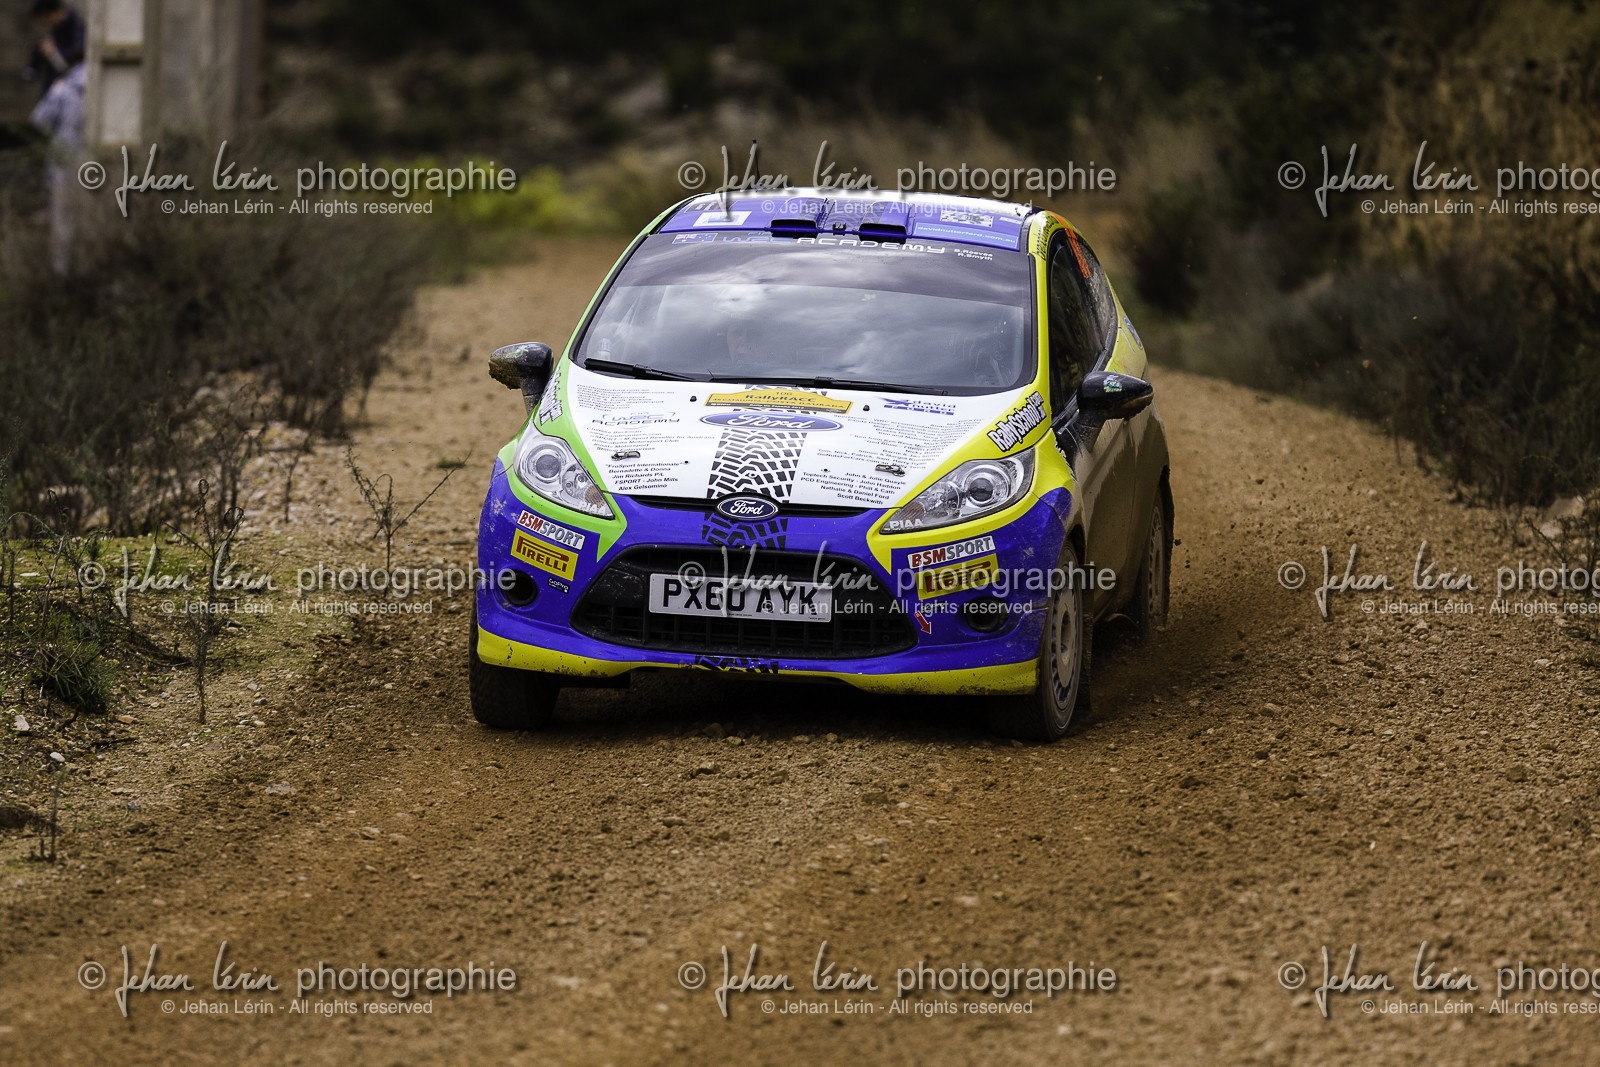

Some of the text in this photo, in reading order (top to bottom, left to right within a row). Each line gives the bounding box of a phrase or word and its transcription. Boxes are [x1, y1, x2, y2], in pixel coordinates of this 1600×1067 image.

[796, 237, 946, 254] ACADEMY
[592, 418, 680, 426] ACADEMY
[727, 414, 816, 429] Ford
[816, 479, 854, 488] Engineering
[853, 489, 874, 497] Daniel
[729, 499, 765, 515] Ford
[889, 518, 924, 530] PIAA
[515, 535, 570, 573] PIRELLI
[663, 578, 819, 616] PX60 AYK
